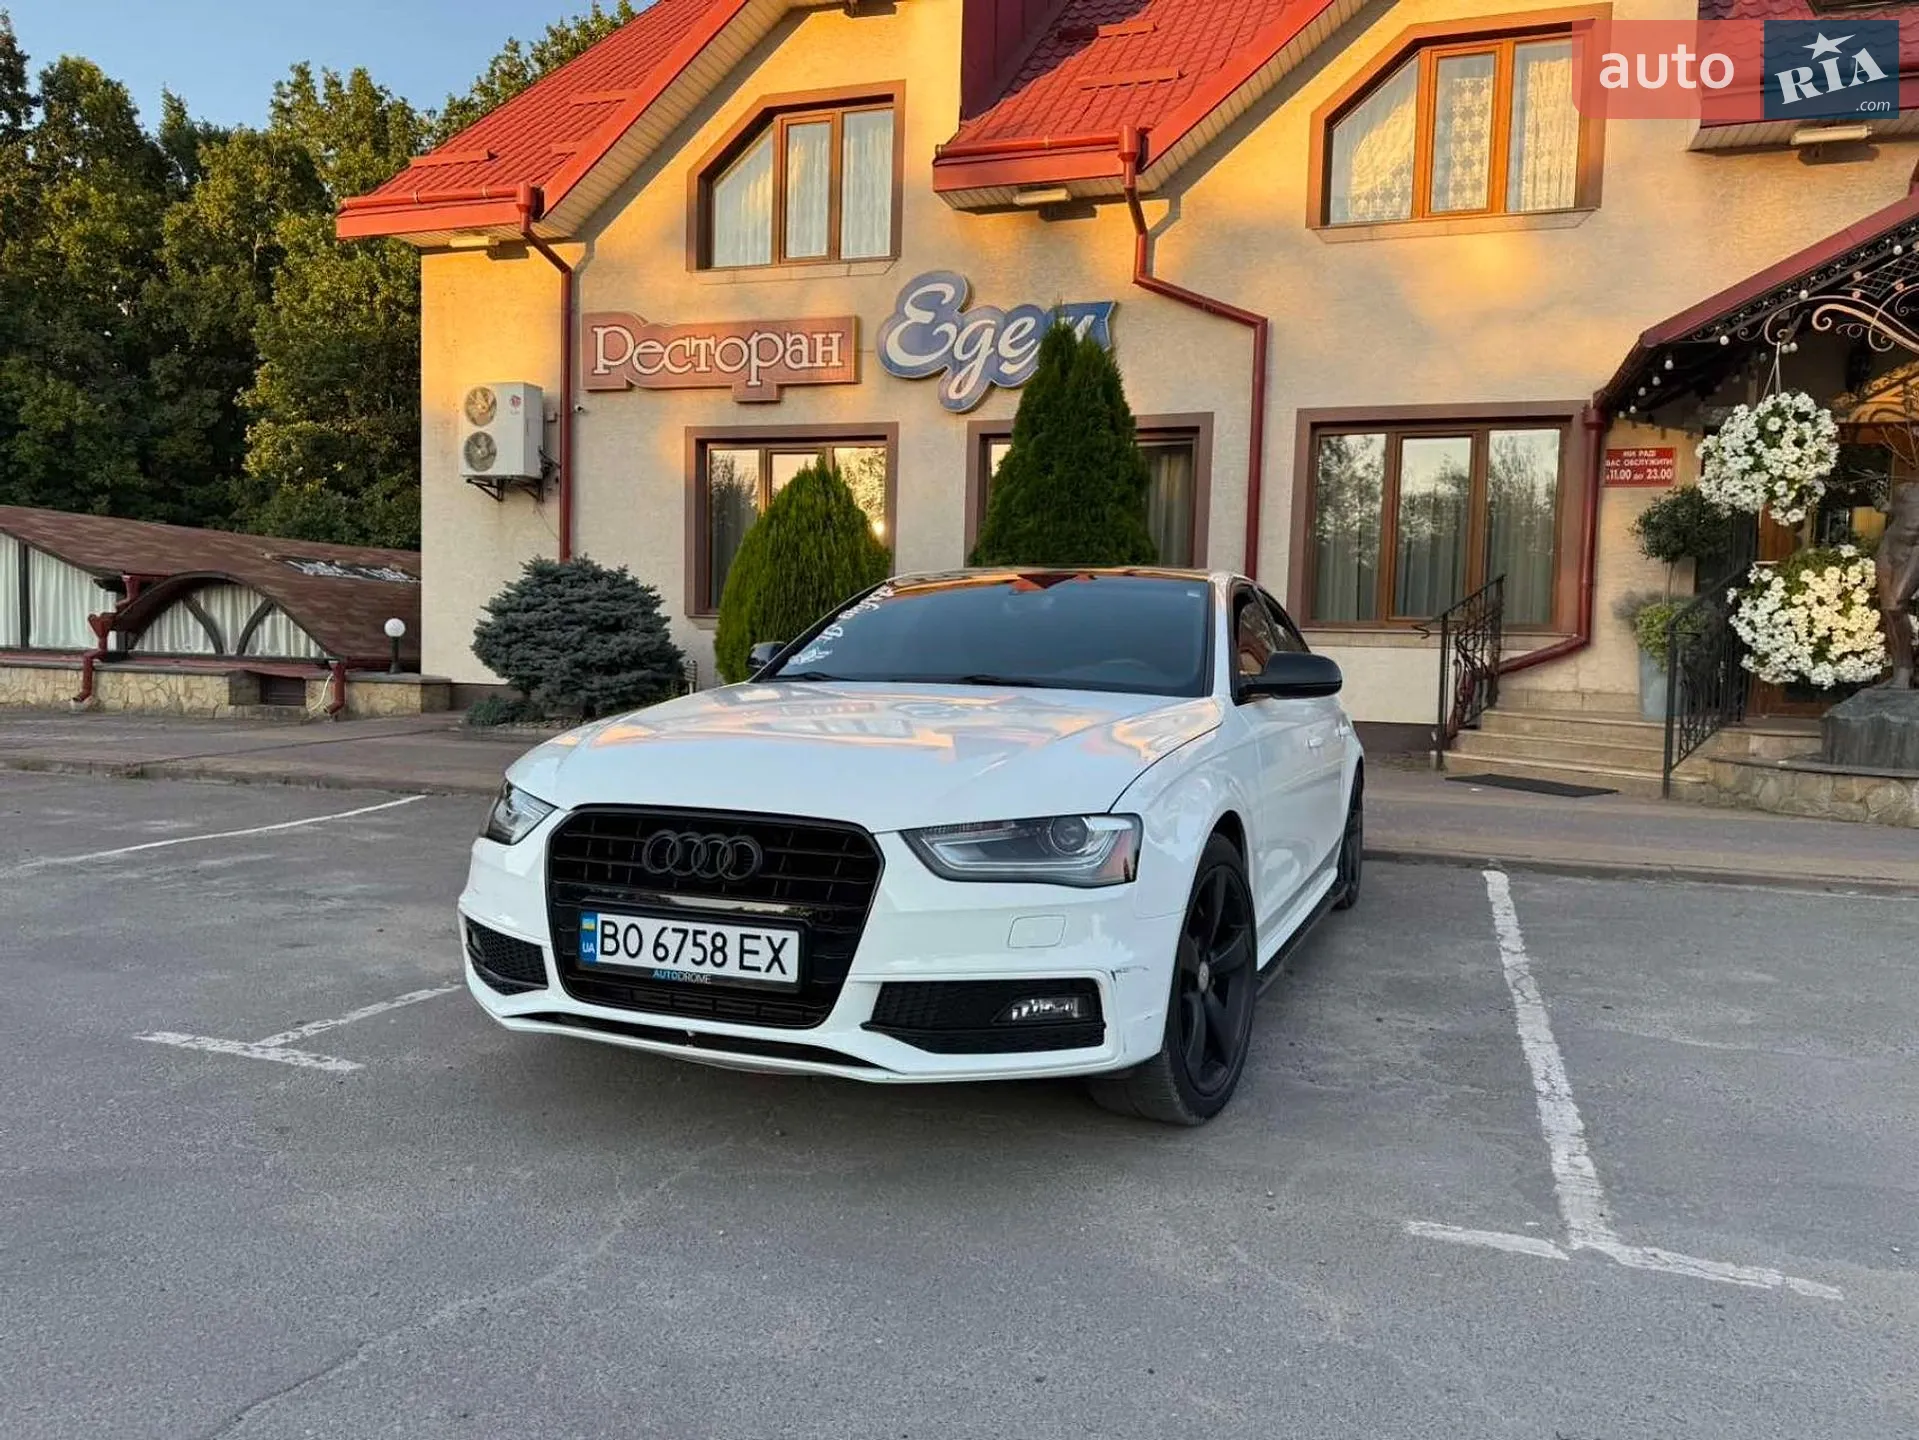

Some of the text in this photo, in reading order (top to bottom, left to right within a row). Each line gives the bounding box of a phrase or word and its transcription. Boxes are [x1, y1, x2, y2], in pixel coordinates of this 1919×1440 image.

[592, 325, 846, 386] Ресторан
[1646, 468, 1673, 480] 23.00
[581, 941, 596, 953] UA
[600, 919, 789, 976] BO 6758 EX
[652, 969, 713, 984] AUTODROME
